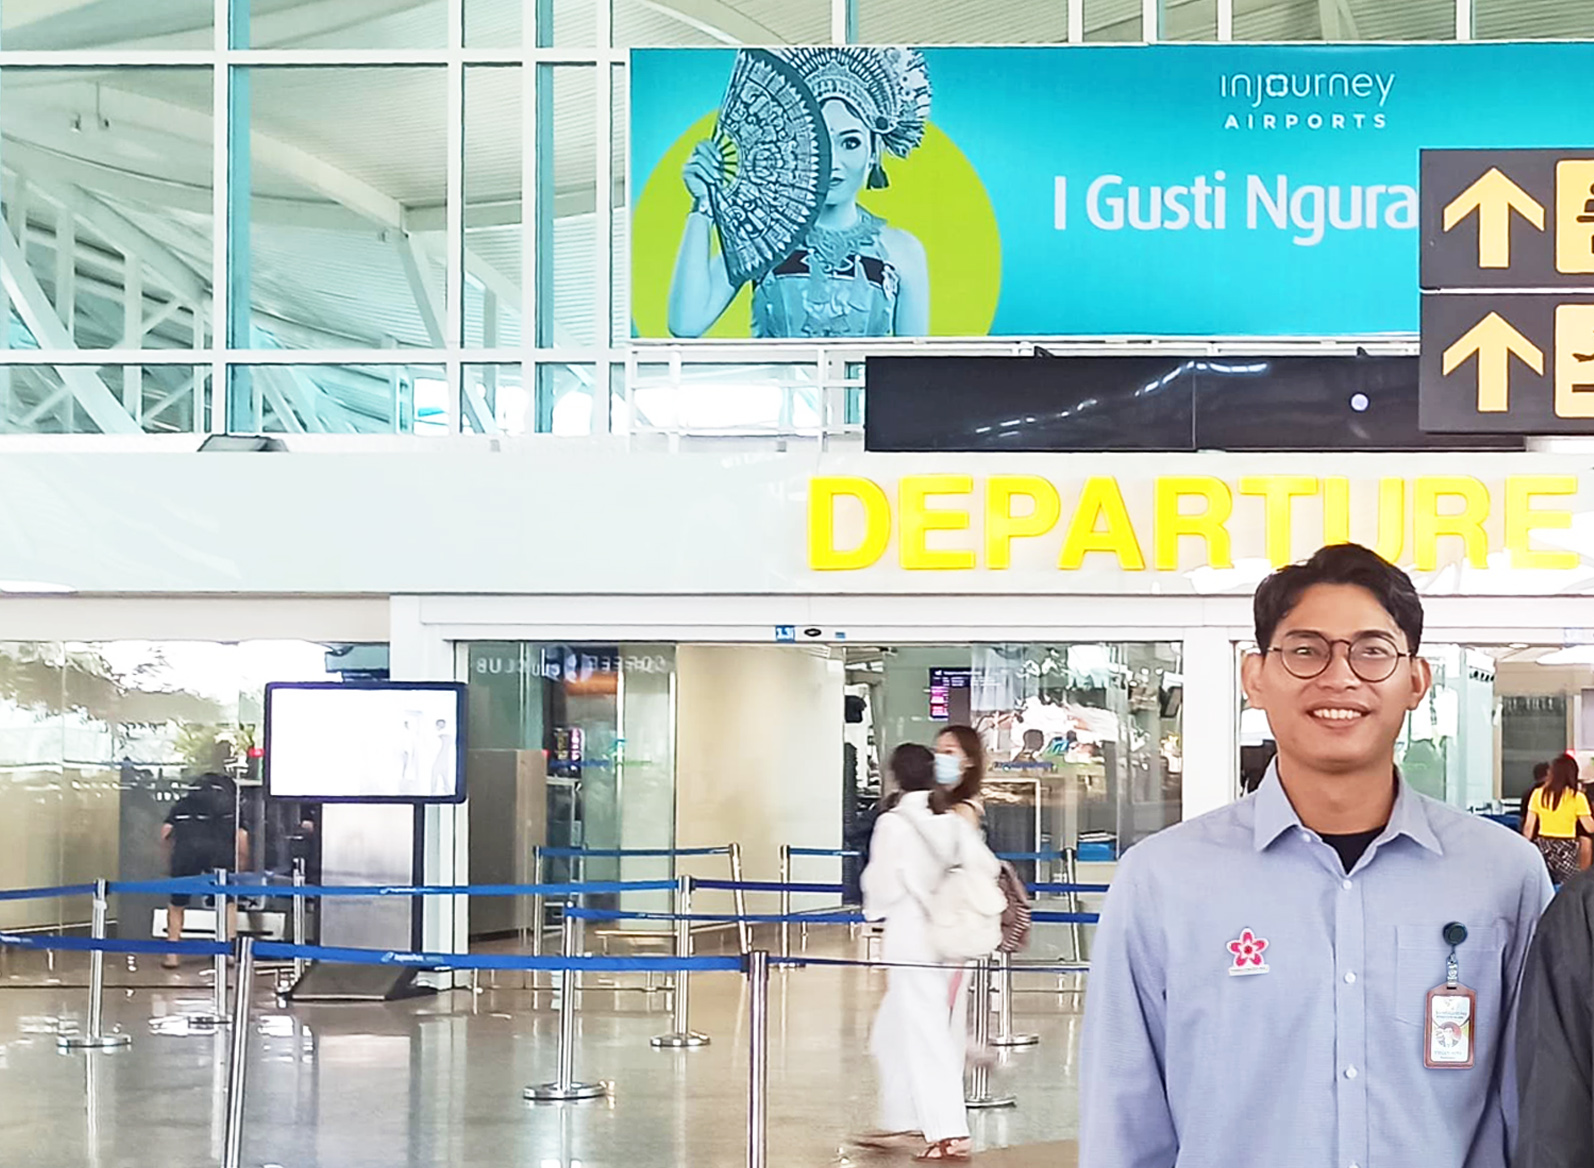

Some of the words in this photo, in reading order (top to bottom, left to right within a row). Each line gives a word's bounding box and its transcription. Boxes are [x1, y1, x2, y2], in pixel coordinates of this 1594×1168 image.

[1224, 114, 1388, 129] AIRPORTS
[1054, 177, 1066, 230] I
[1087, 170, 1227, 231] Gusti
[807, 473, 1581, 571] DEPARTURE
